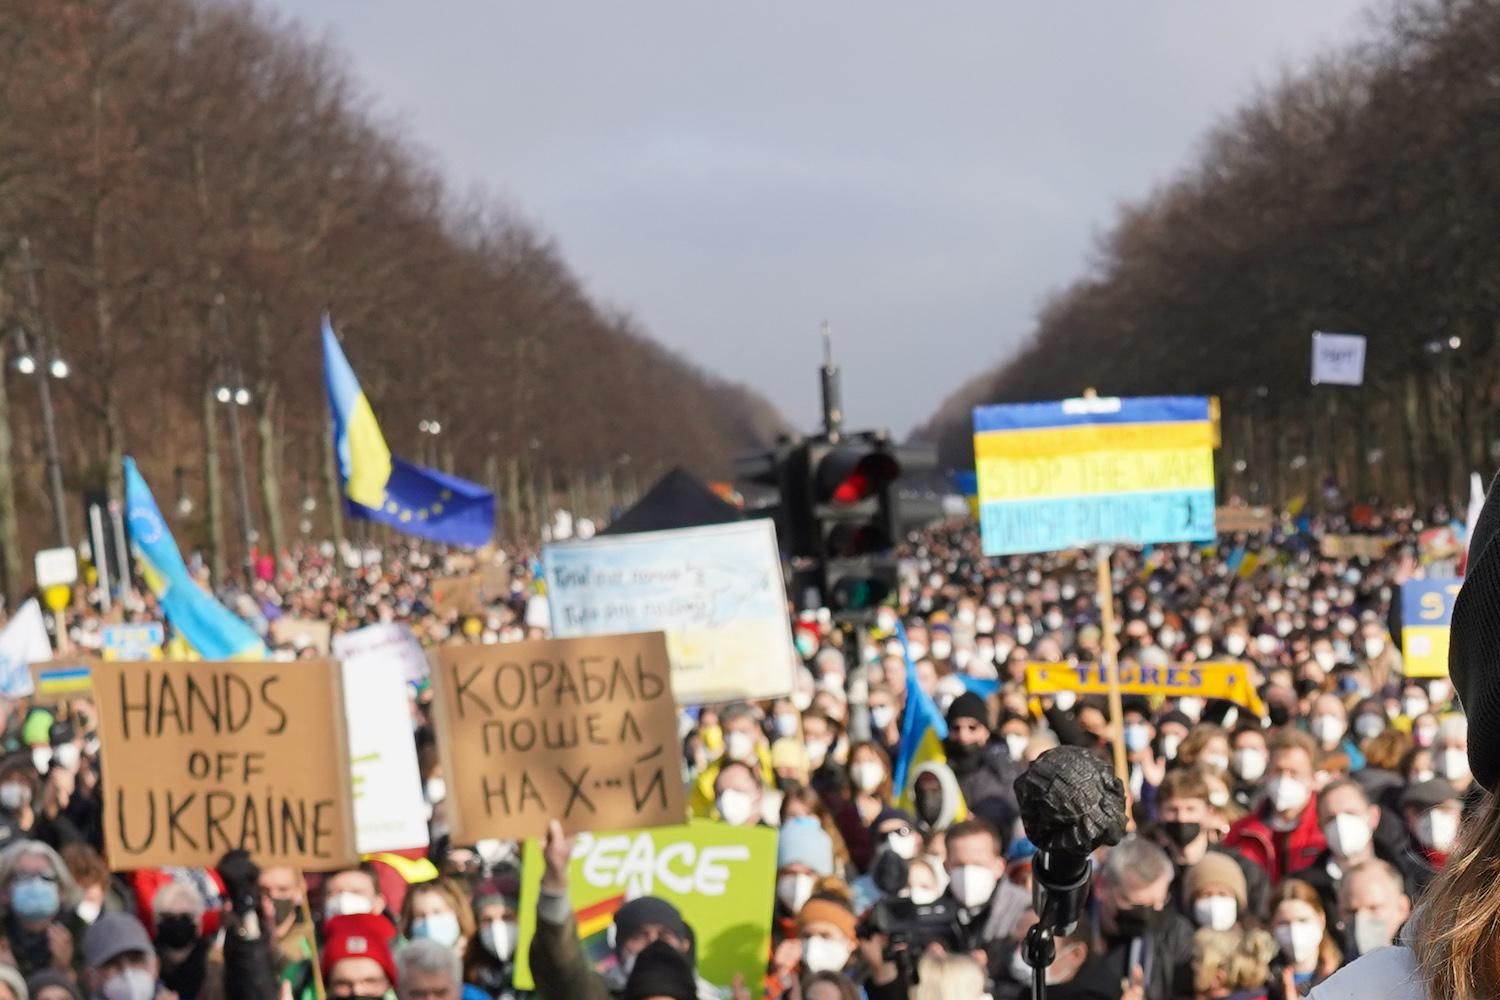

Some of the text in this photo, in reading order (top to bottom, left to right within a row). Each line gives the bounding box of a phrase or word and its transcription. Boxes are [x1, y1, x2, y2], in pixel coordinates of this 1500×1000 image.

[1075, 454, 1129, 490] THE
[119, 671, 288, 740] HANDS
[453, 654, 665, 719] КОРАБЛЬ
[482, 709, 643, 757] ПОШЕЛ
[187, 750, 266, 784] OFF
[482, 768, 547, 819] НА
[570, 831, 751, 900] PEACE
